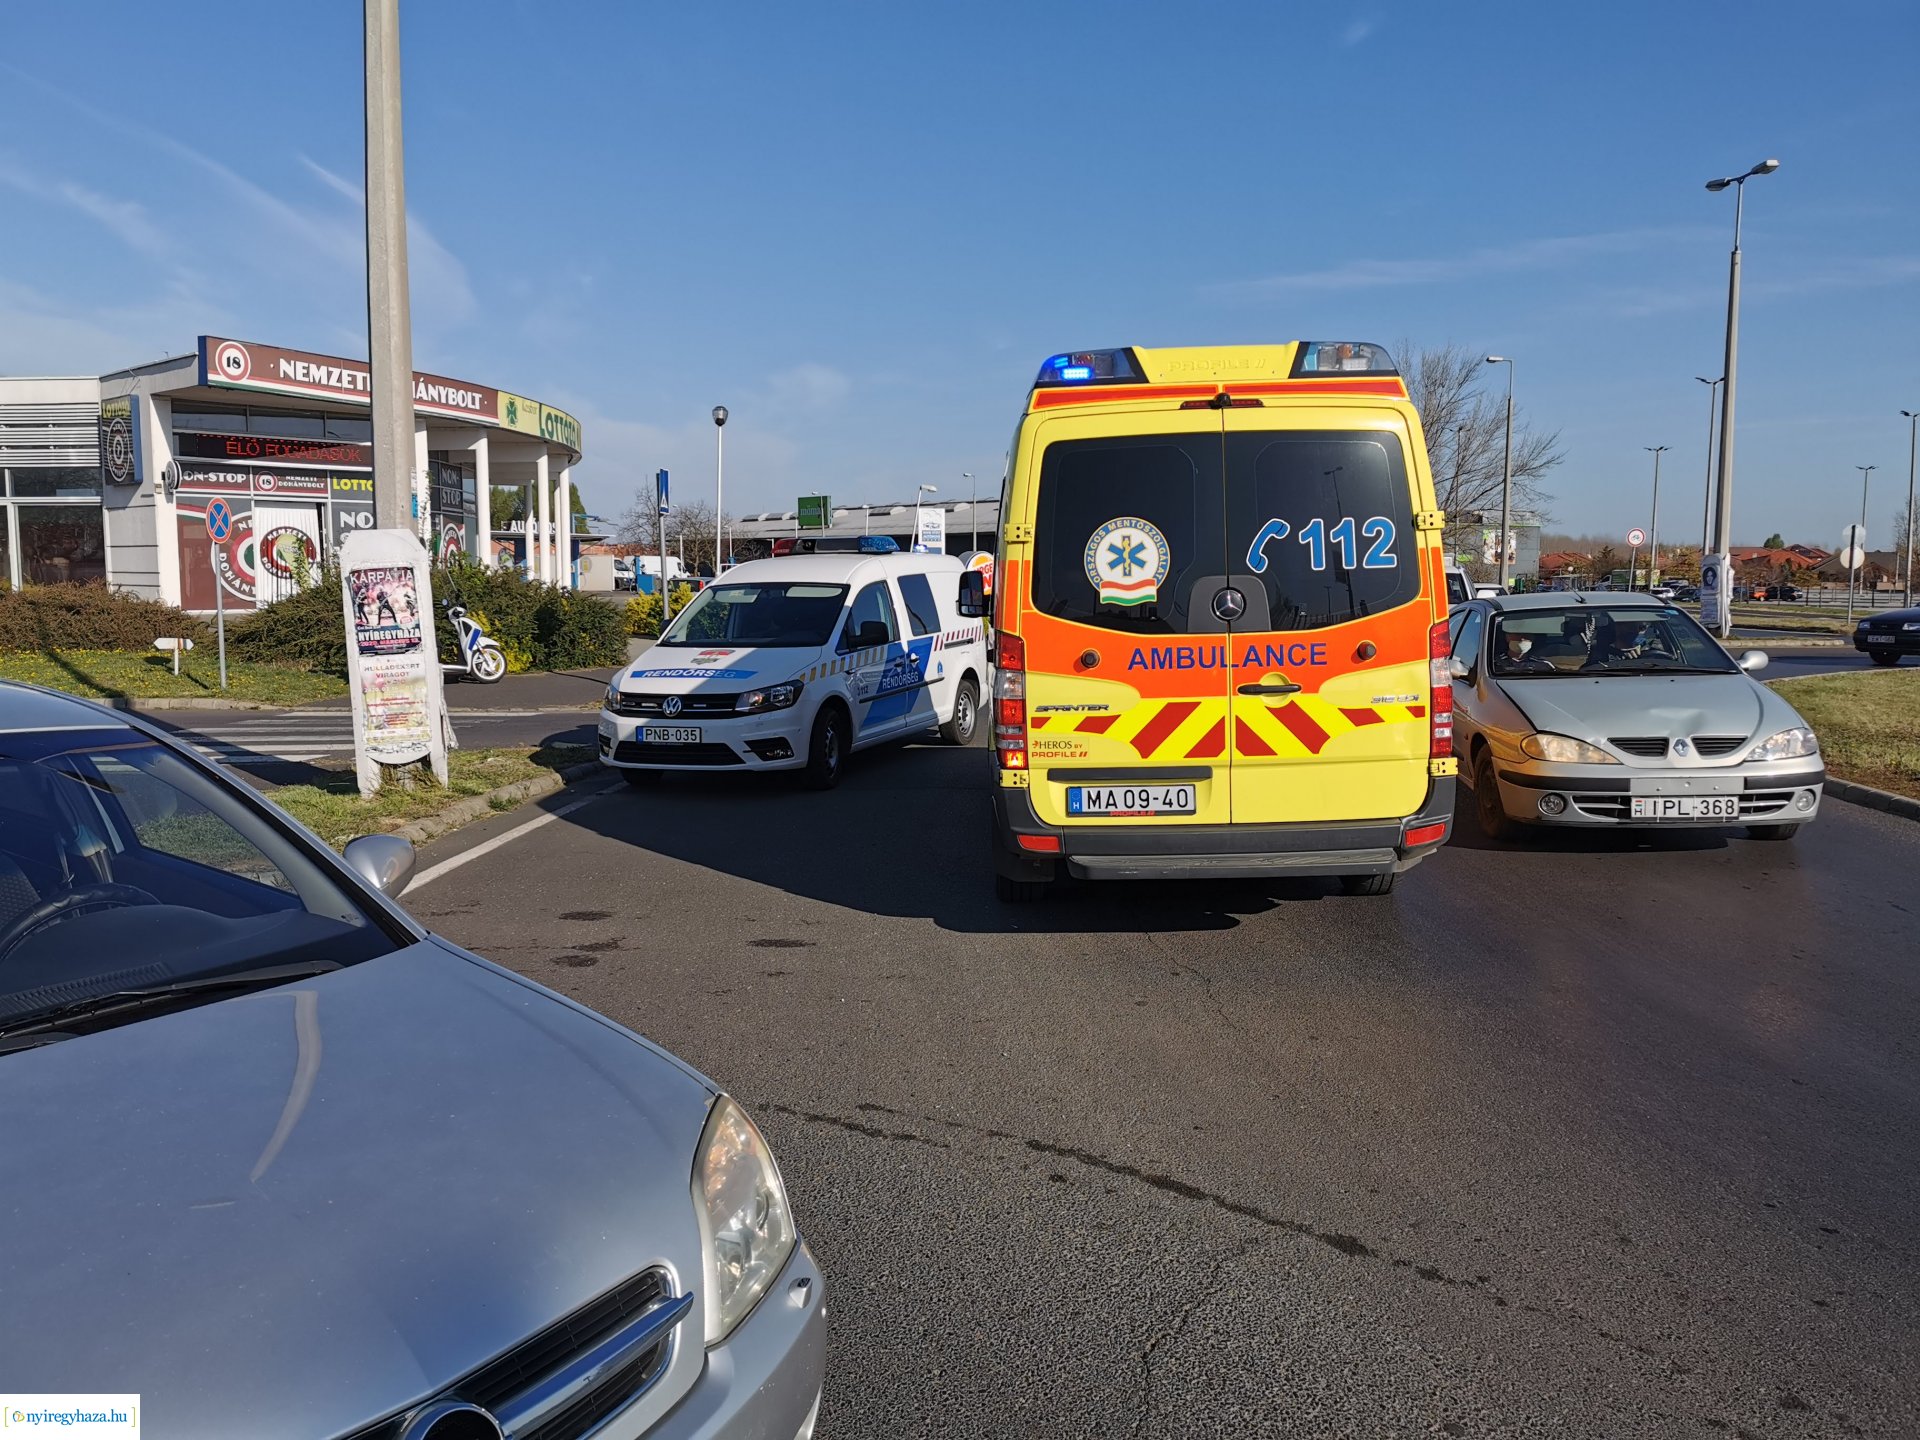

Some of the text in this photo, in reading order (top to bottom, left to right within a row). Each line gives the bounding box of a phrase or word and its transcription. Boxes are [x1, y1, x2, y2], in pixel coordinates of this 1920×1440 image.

[226, 356, 241, 370] 18
[180, 469, 246, 483] ON-STOP
[1299, 517, 1397, 570] 112
[1127, 643, 1328, 671] AMBULANCE
[1035, 704, 1109, 713] SPRINTER
[645, 729, 698, 741] PNB-035
[1039, 740, 1072, 750] HEROS
